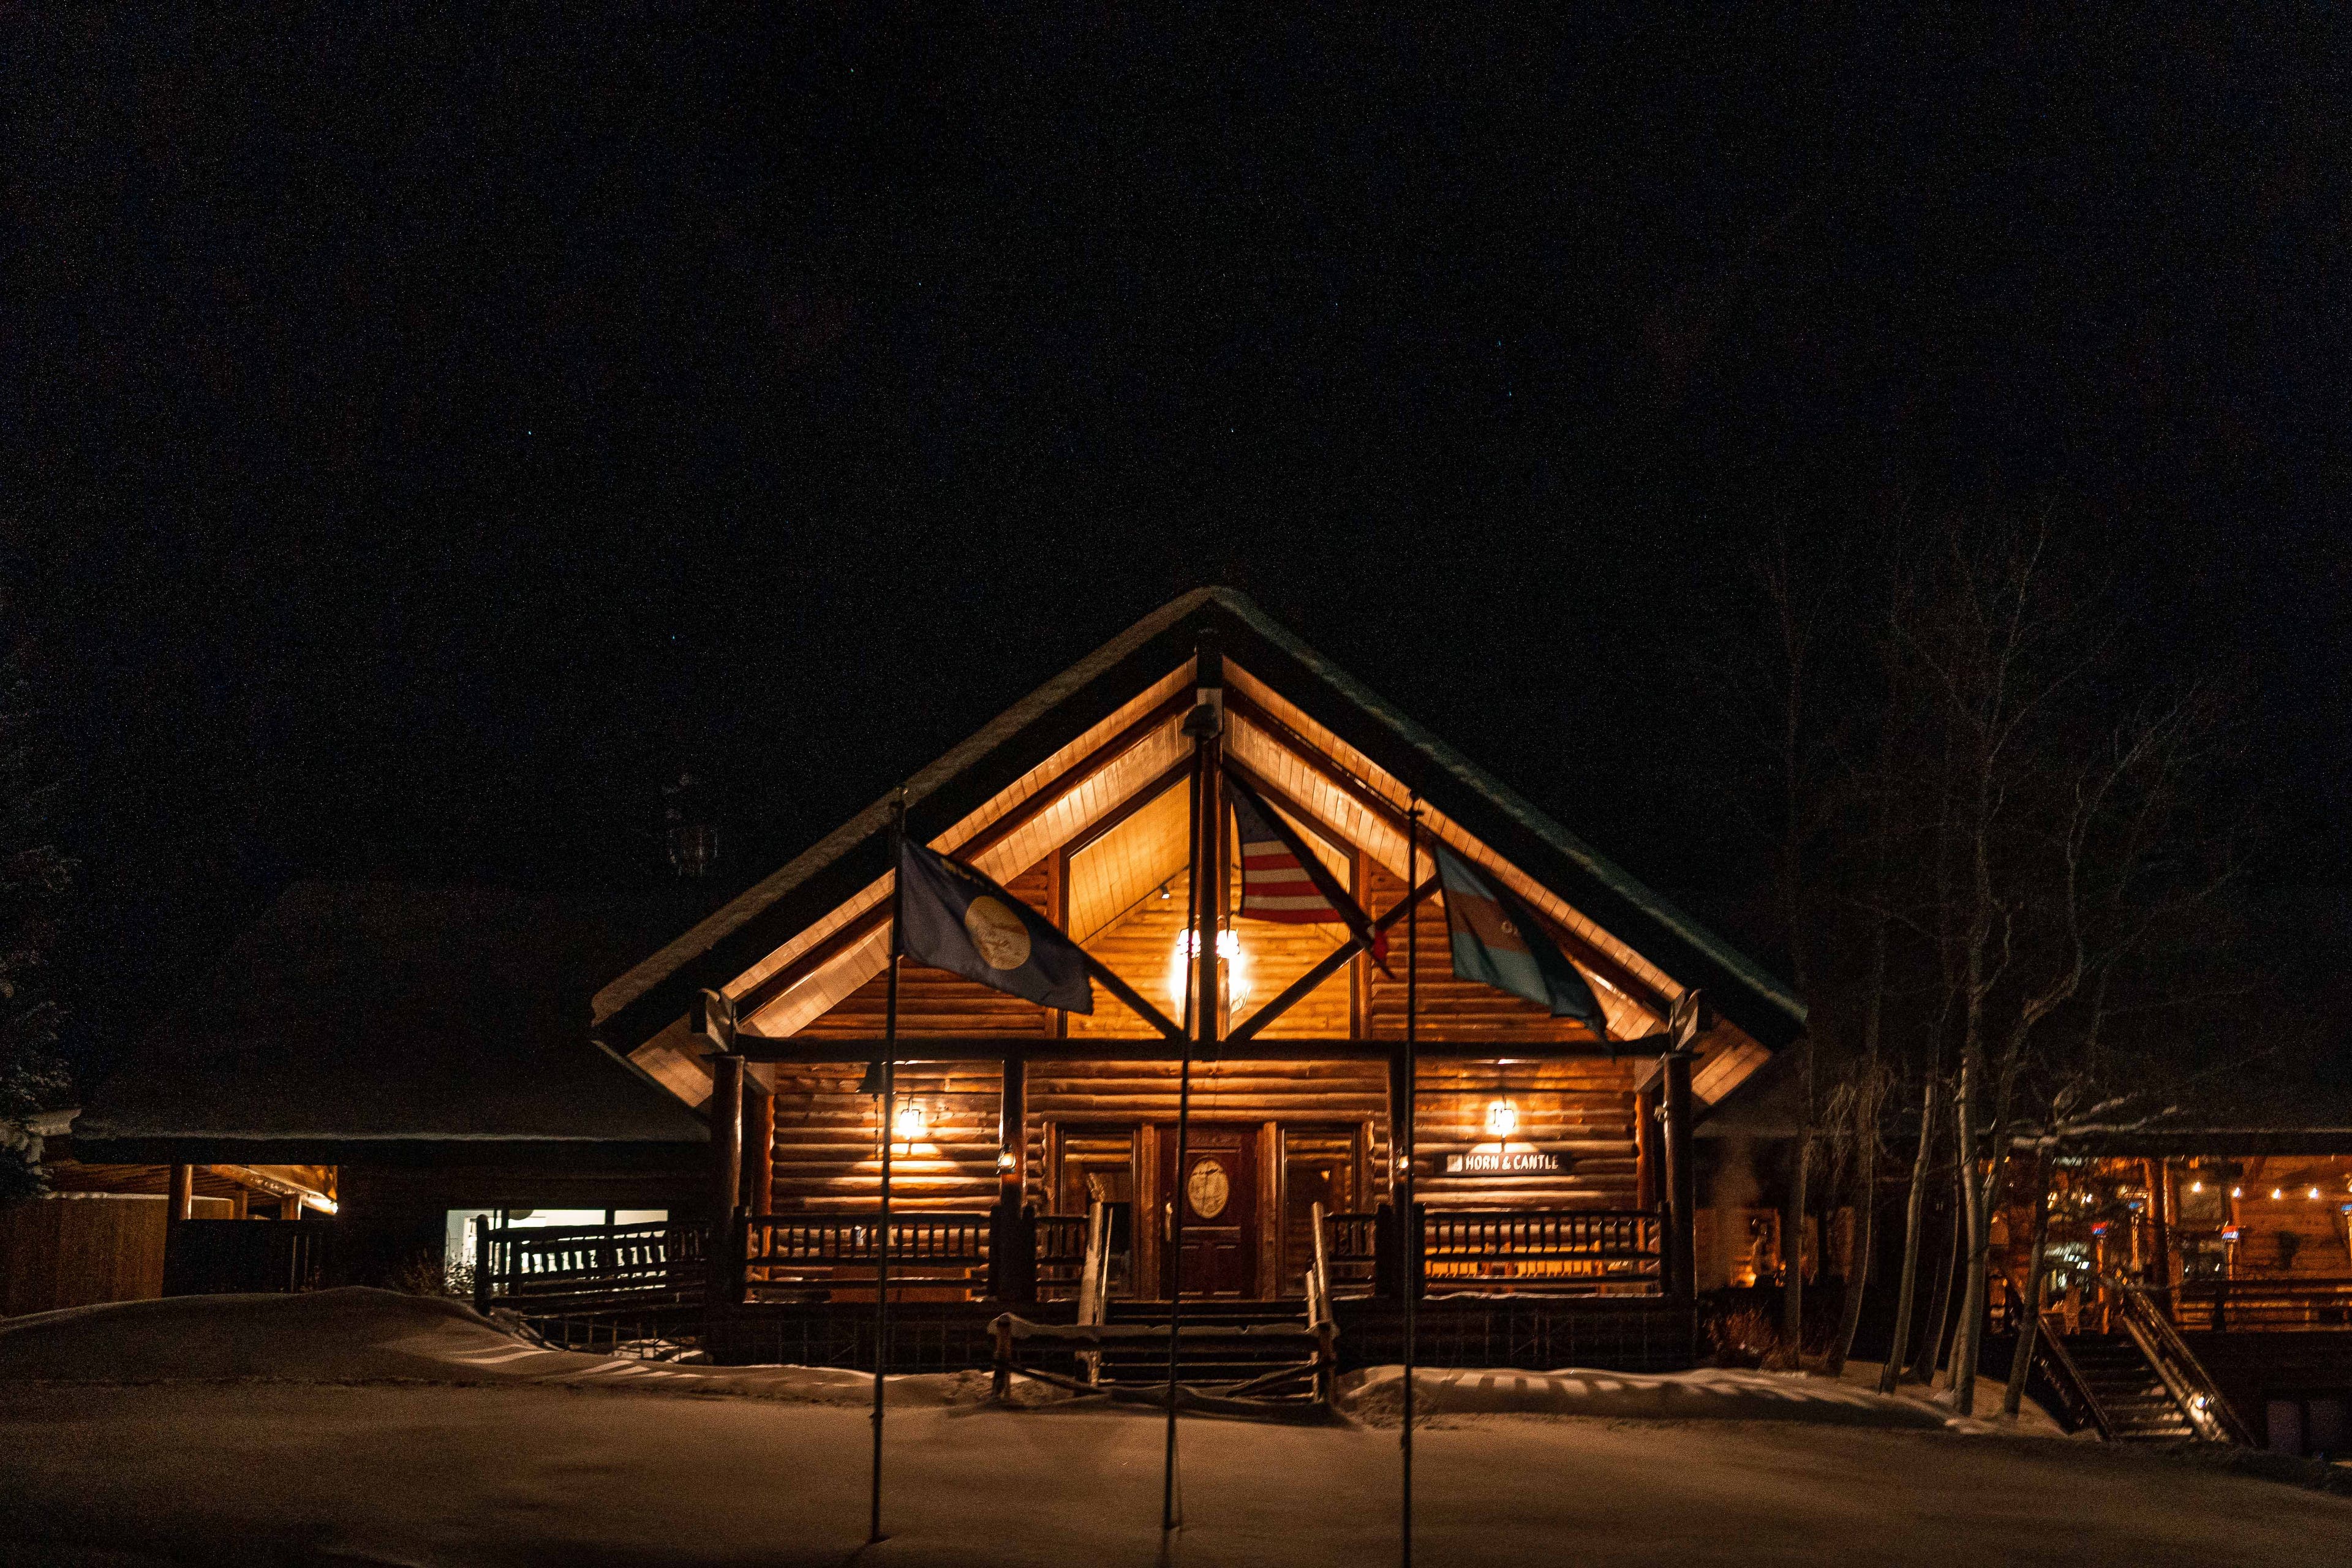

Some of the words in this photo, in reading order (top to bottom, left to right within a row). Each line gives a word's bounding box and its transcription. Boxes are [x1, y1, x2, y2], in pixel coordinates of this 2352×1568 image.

[1466, 1155, 1499, 1170] HORN
[1502, 1155, 1512, 1170] &
[1513, 1155, 1559, 1170] CANTLE
